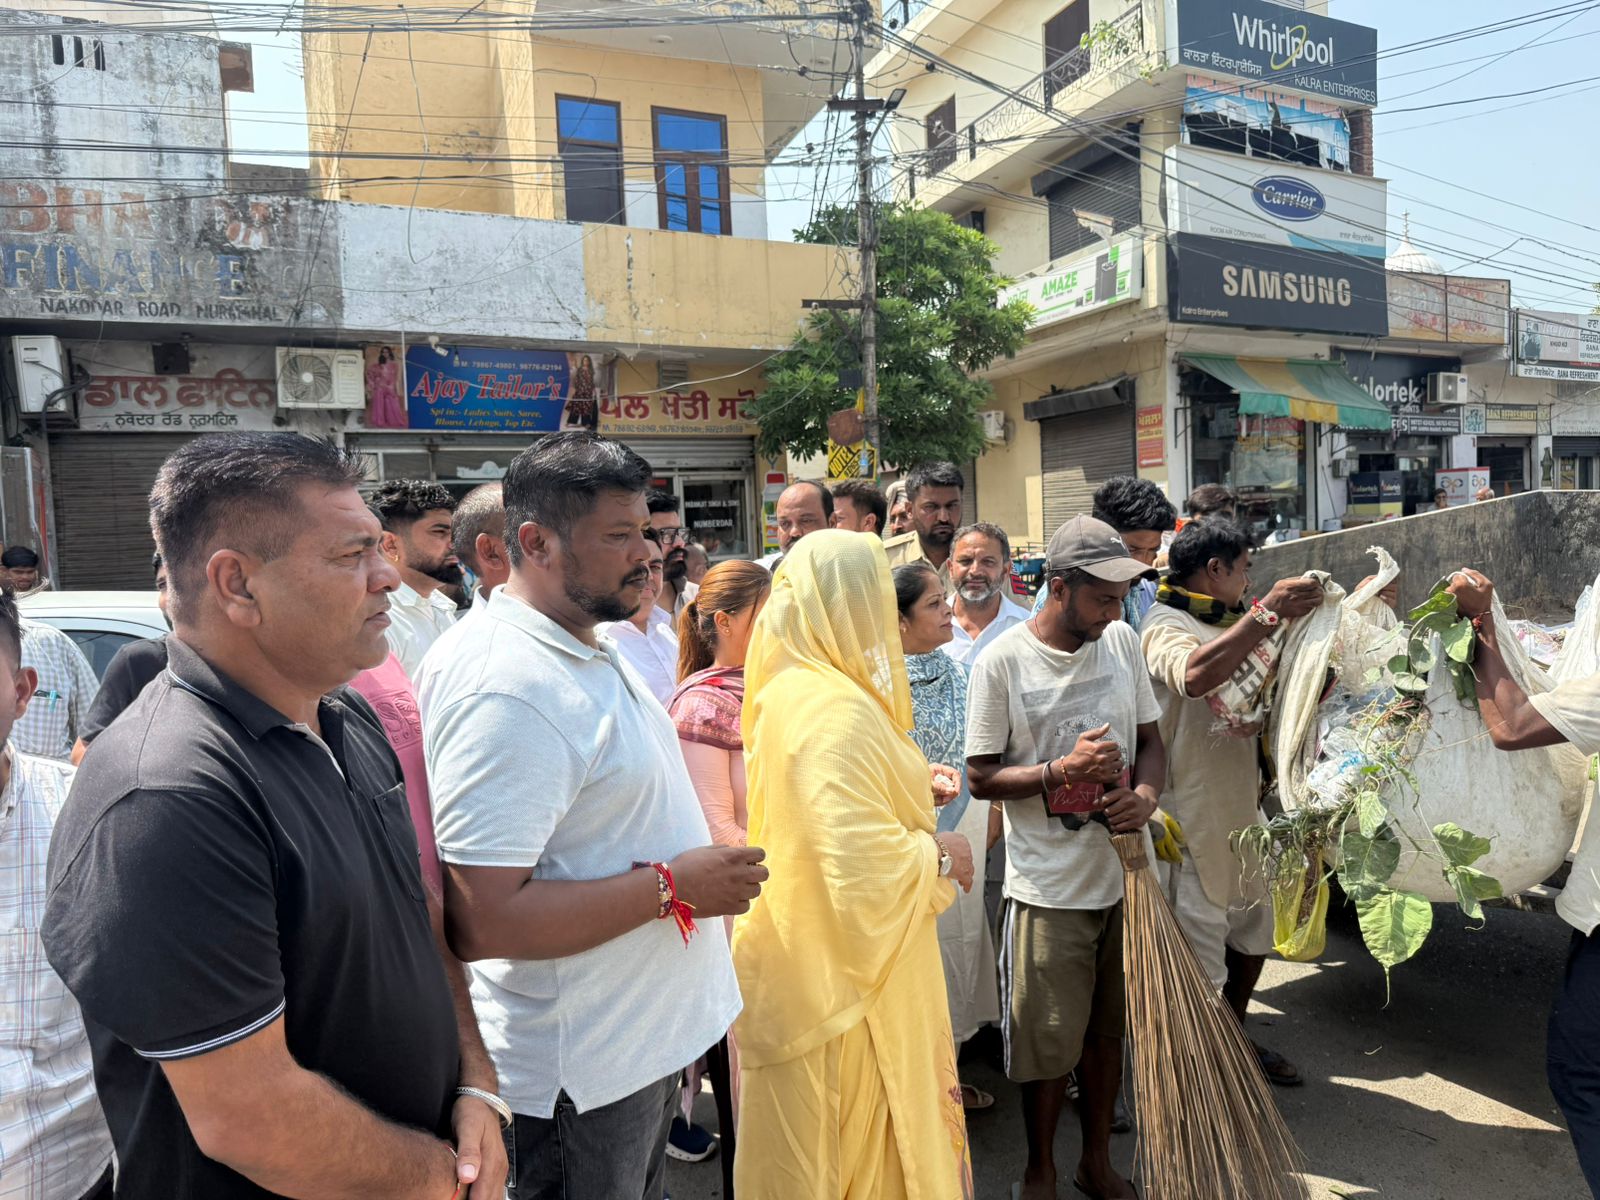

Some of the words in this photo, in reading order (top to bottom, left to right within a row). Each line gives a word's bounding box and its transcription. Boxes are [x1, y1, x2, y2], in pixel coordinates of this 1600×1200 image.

[1232, 12, 1334, 67] Whirlpool
[1294, 74, 1322, 92] KALRA
[1323, 80, 1376, 102] ENTERPRISES
[1262, 185, 1317, 207] Carrier
[1041, 271, 1078, 298] AMAZE
[1222, 265, 1351, 307] SAMSUNG
[40, 297, 124, 316] NAKODAR
[138, 301, 181, 318] ROAD
[1198, 307, 1229, 319] Enterprises
[411, 371, 470, 404] Ajay
[477, 373, 562, 401] Tailor's
[1557, 369, 1569, 378] RANA
[1570, 370, 1599, 379] REFRESHMENT
